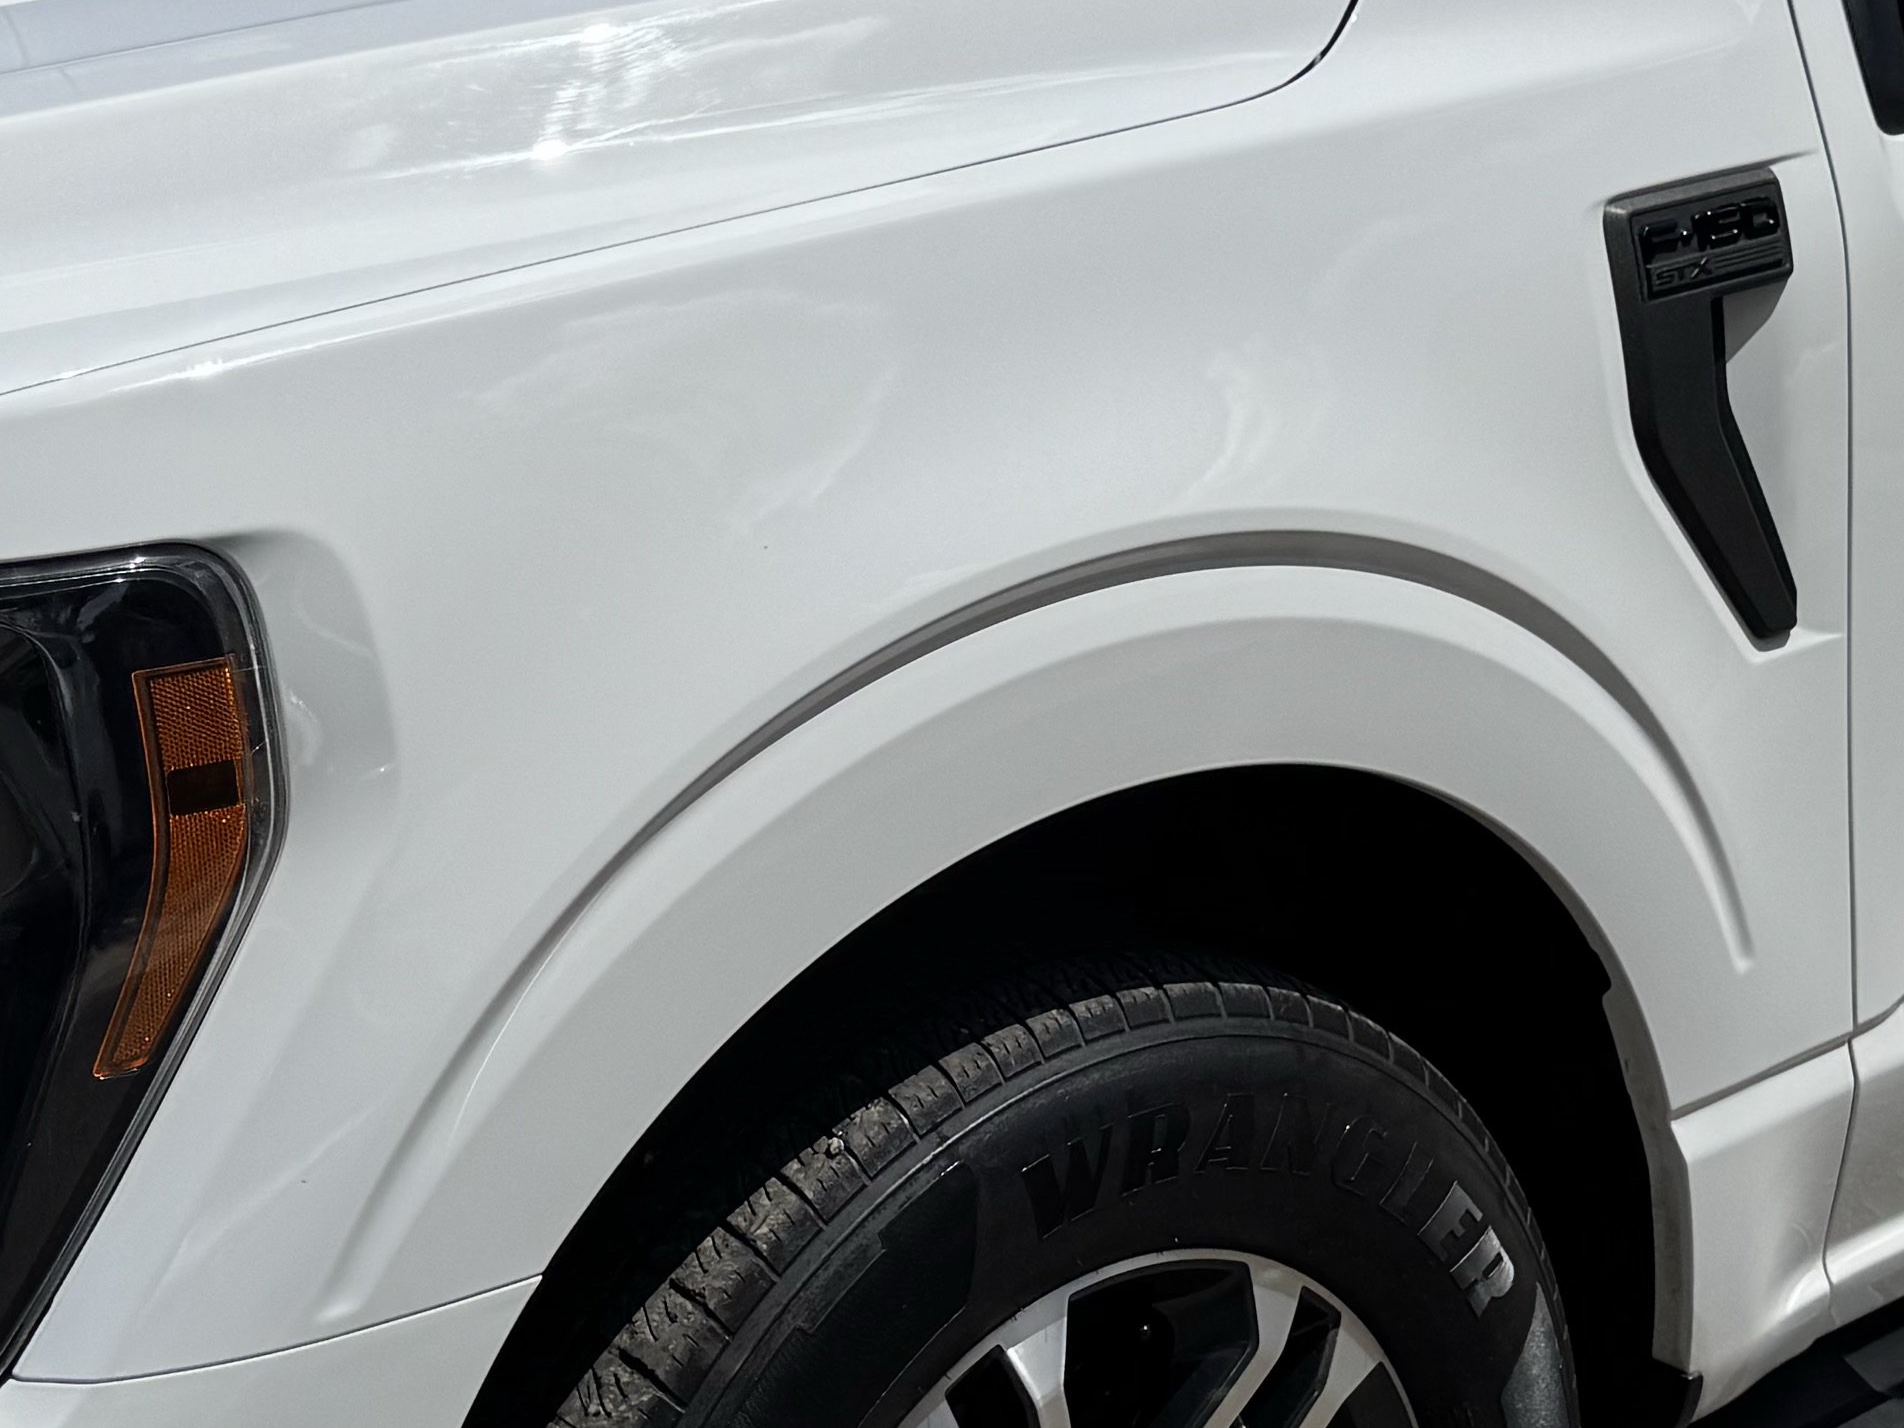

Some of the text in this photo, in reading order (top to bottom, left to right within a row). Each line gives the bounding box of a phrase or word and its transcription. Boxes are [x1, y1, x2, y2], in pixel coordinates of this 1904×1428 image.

[1639, 196, 1780, 265] F-150
[1655, 256, 1712, 285] STX
[1019, 1091, 1515, 1320] WRANGLER
